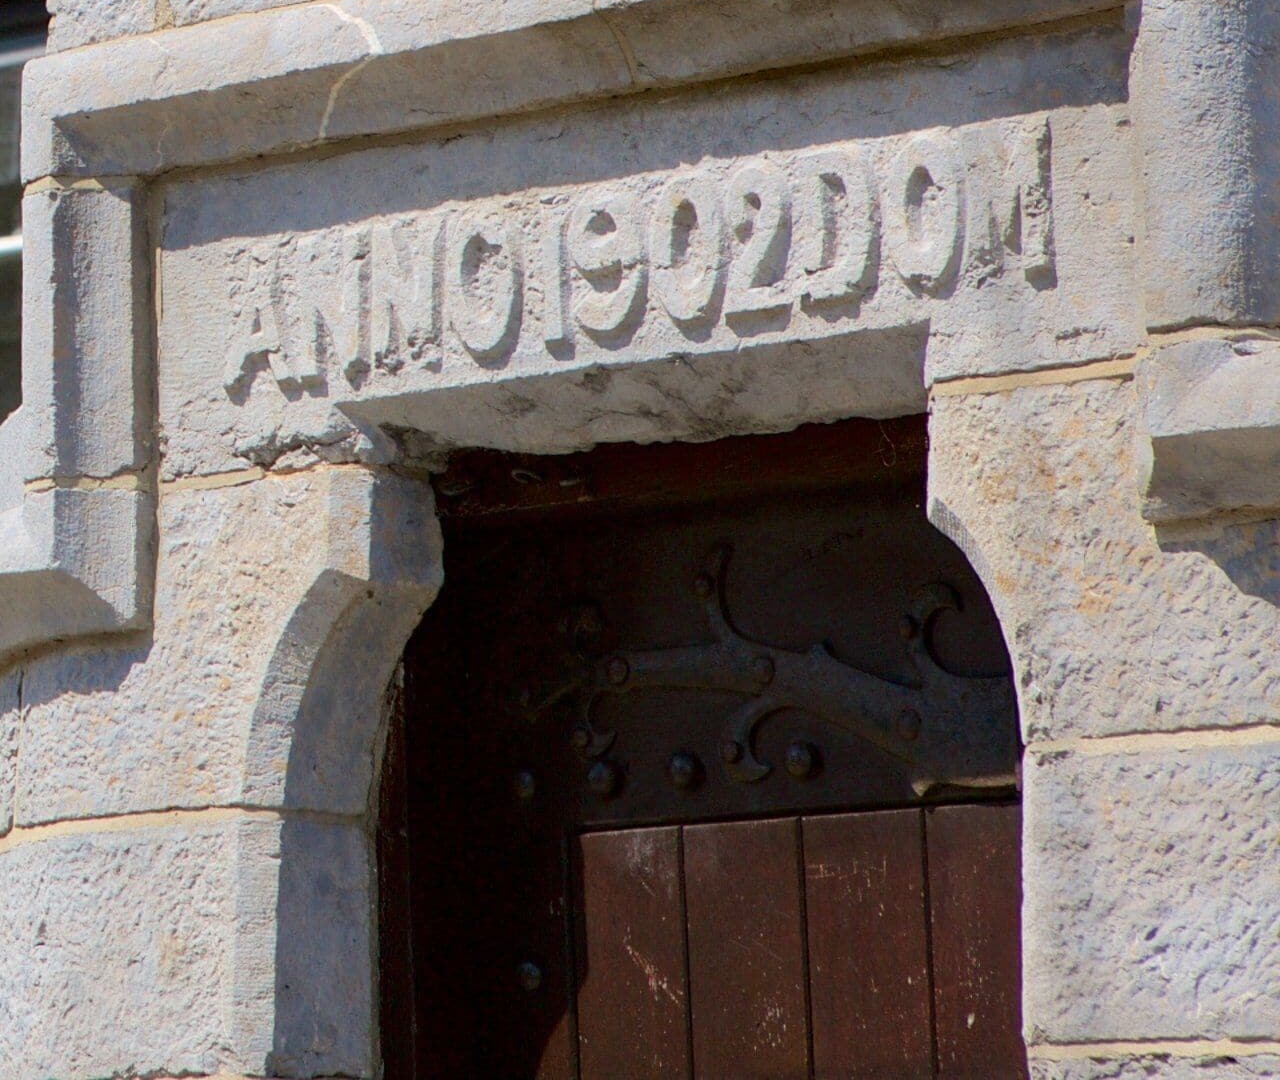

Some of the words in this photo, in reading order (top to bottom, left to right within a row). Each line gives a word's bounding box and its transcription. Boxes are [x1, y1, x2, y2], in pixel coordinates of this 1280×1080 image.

[224, 208, 522, 398] ANNO
[543, 166, 792, 352] 1902
[797, 116, 1055, 318] DOM
